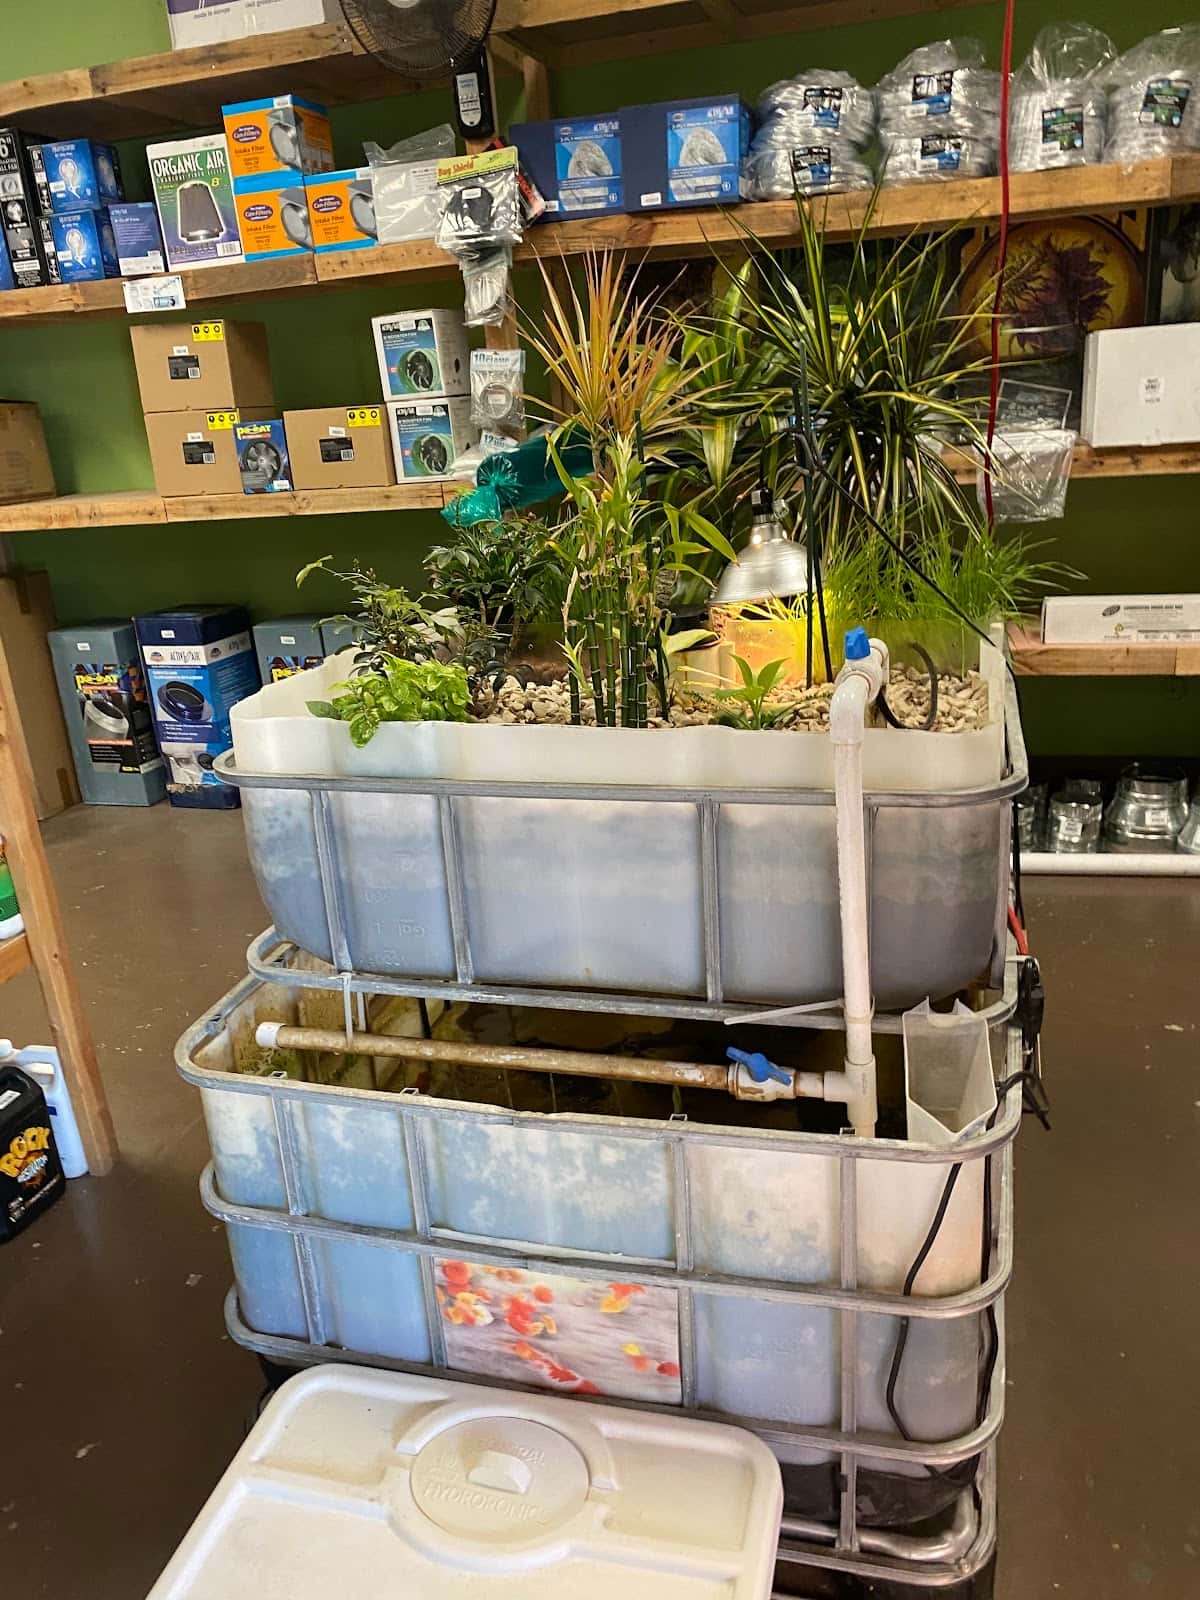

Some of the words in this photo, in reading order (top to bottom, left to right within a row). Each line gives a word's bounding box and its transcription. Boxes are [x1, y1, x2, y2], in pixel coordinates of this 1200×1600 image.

[153, 153, 203, 178] ORGANIC
[207, 150, 226, 169] AIR
[453, 160, 474, 171] Shield
[0, 1127, 50, 1178] ROCK
